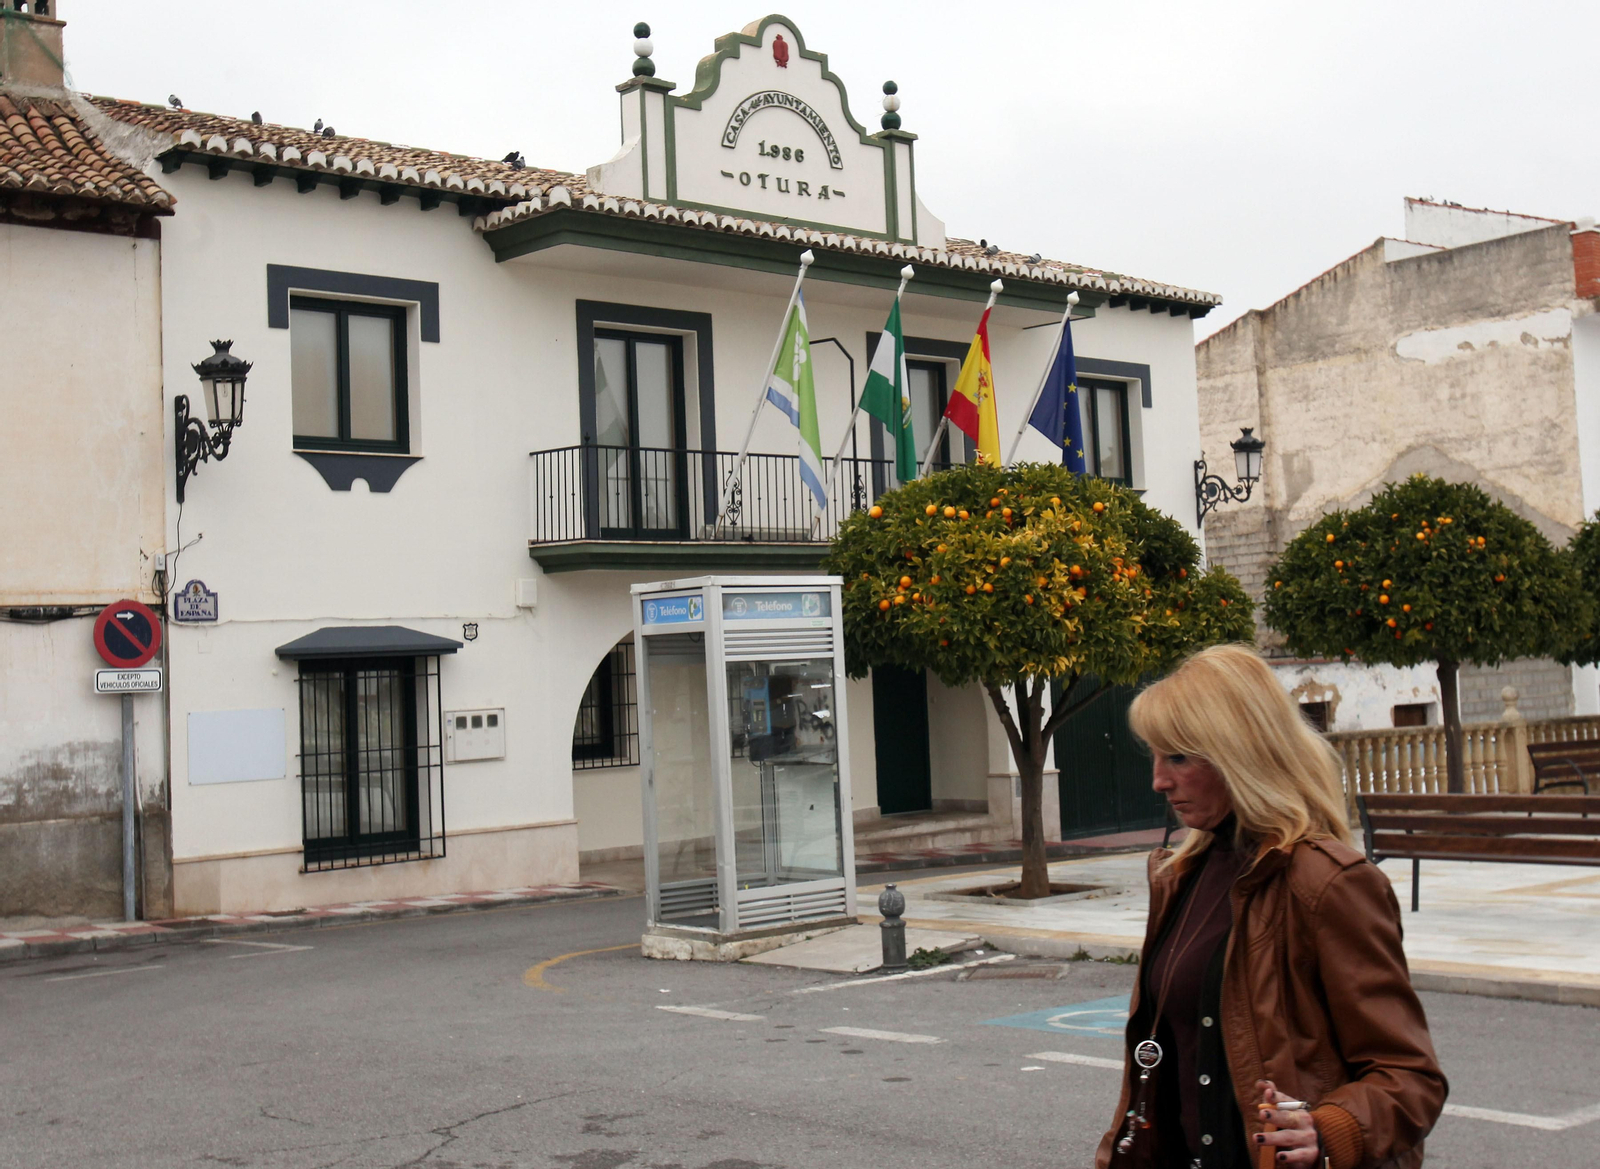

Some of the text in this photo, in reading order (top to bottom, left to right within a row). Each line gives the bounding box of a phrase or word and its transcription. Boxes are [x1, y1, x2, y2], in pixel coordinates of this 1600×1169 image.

[726, 92, 841, 165] CASA AYUNTAMIENTO
[660, 605, 687, 616] Teléfono
[755, 600, 793, 612] Teléfono
[180, 609, 213, 617] ESPAÑA
[117, 673, 141, 681] EXCEPTO
